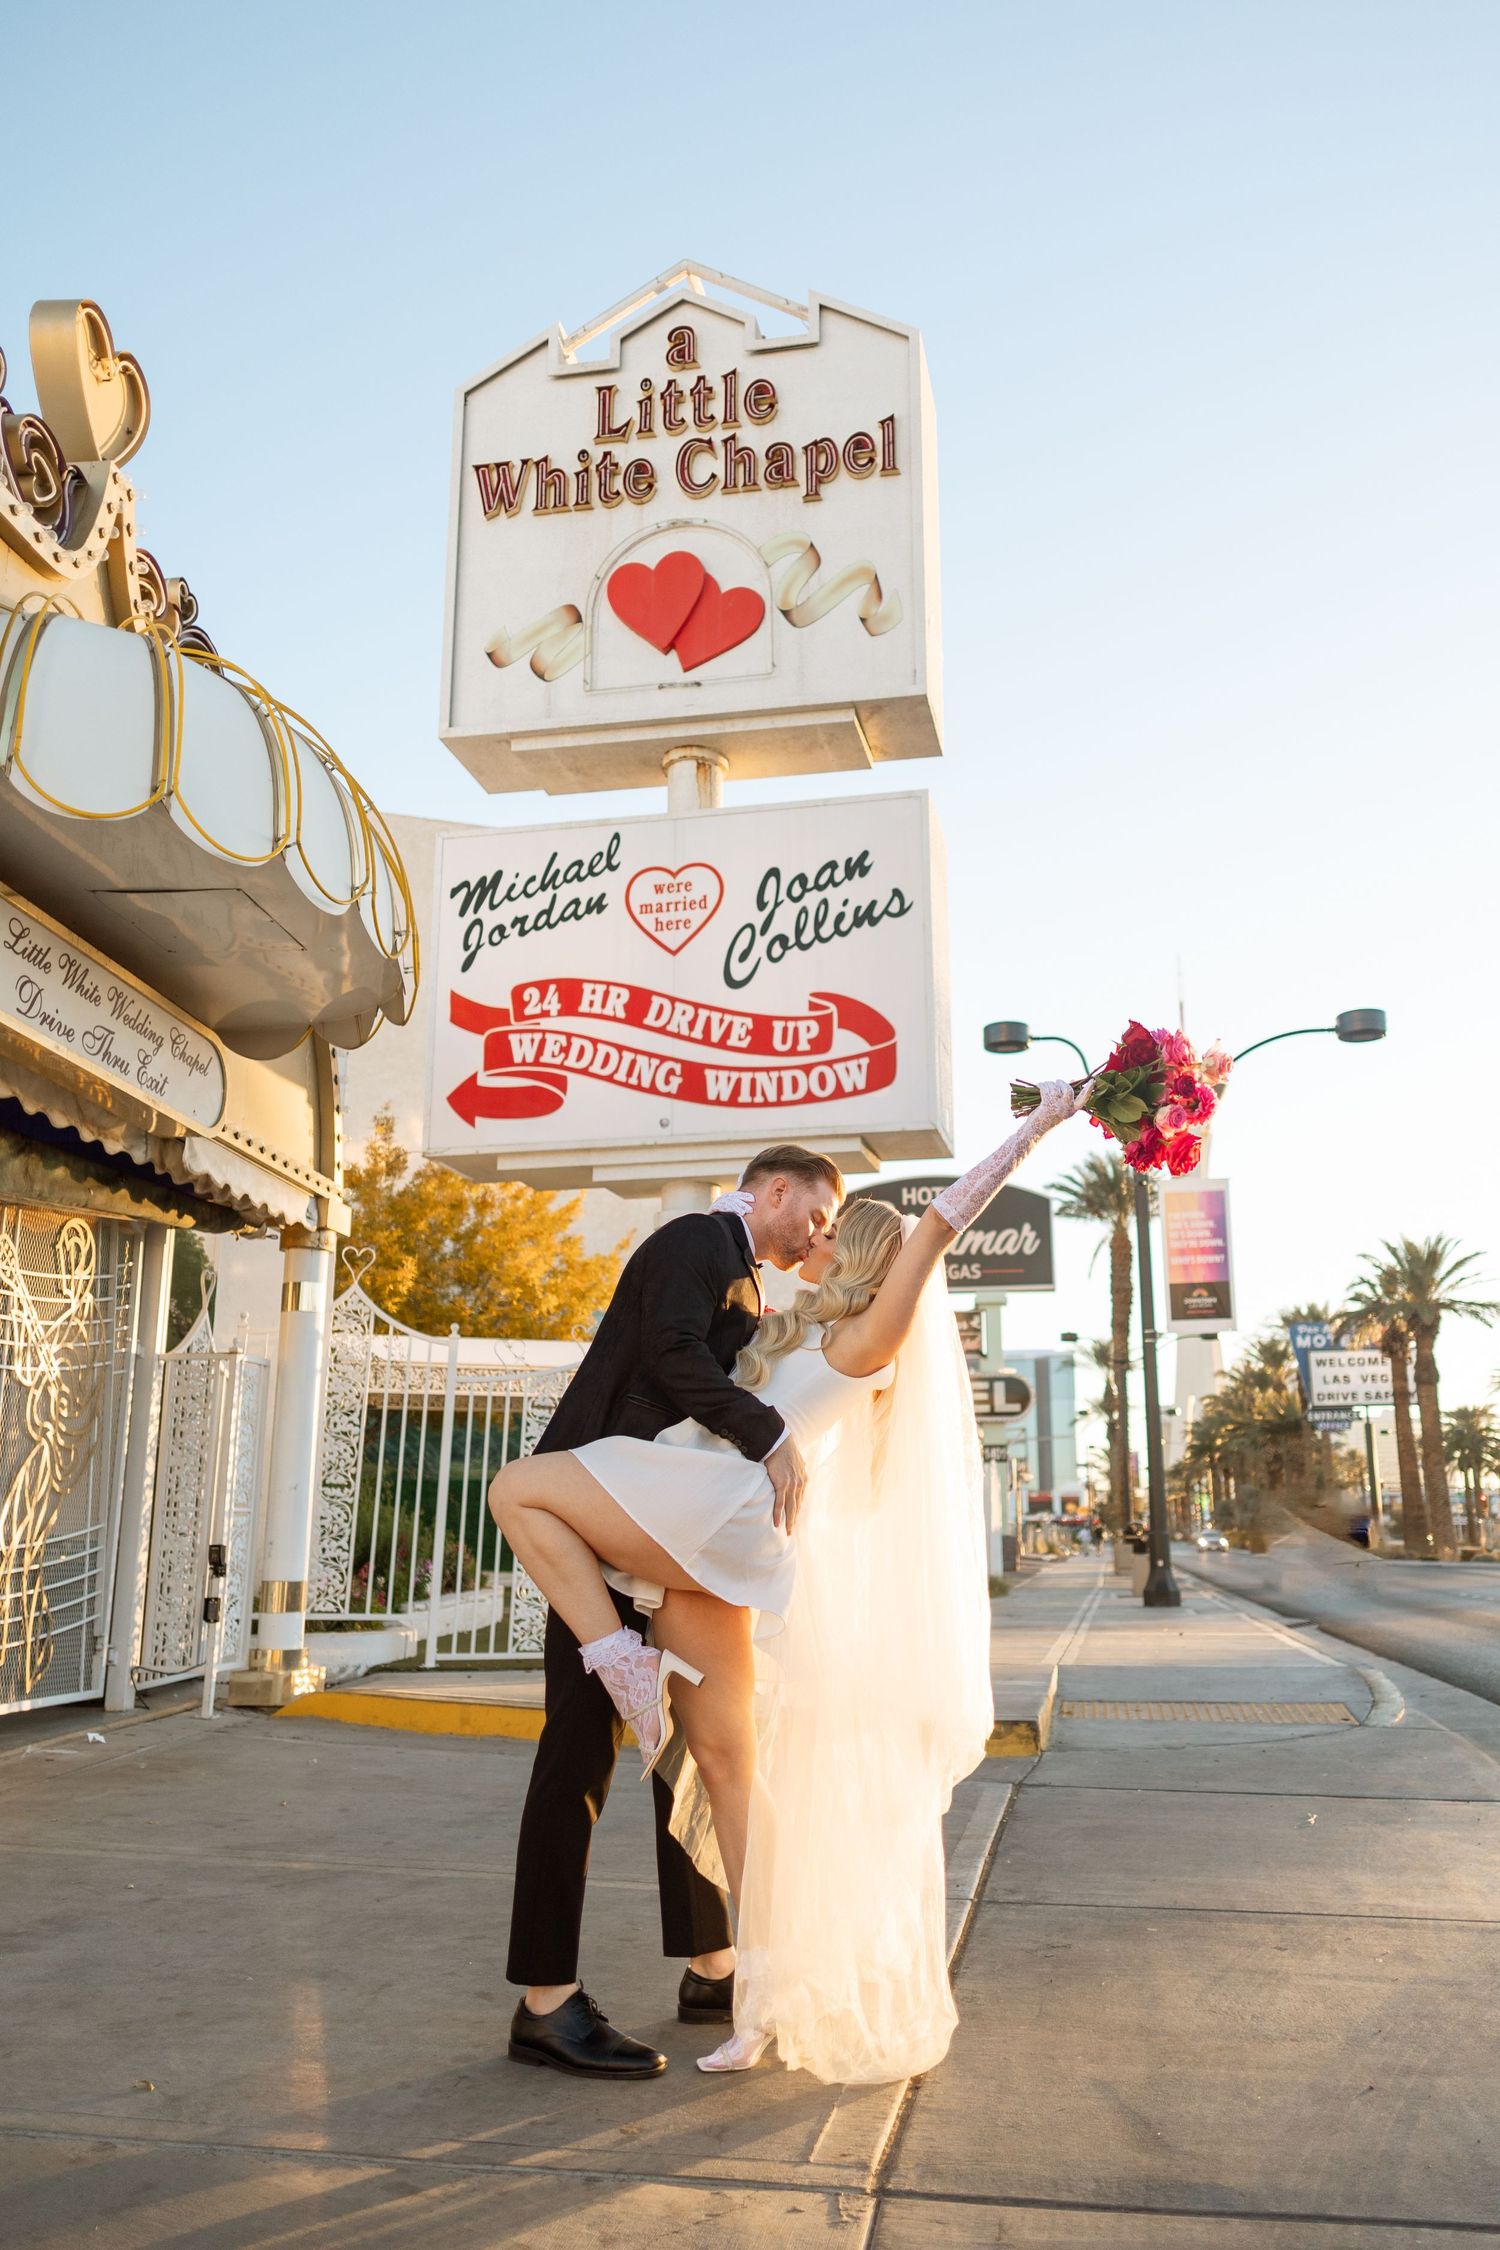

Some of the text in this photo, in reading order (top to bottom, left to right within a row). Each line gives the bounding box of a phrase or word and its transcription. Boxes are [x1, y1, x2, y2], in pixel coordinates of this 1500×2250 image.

[666, 325, 699, 369] a
[594, 368, 778, 444] Little
[473, 414, 901, 521] White Chapel
[450, 831, 622, 918] Michael
[639, 895, 708, 915] married
[653, 879, 693, 896] were
[756, 849, 874, 936] Joan
[461, 892, 609, 973] Jordan
[654, 916, 692, 933] here
[724, 887, 914, 990] Collins
[3, 917, 213, 1077] Little White Wedding Chapel
[523, 982, 820, 1054] 24 HR DRIVE UP
[16, 975, 169, 1096] Drive Thru Exit
[509, 1032, 870, 1104] WEDDING WINDOW
[1315, 1357, 1391, 1368] WELCOME
[1316, 1391, 1359, 1402] DRIVE
[1323, 1375, 1351, 1385] LAS
